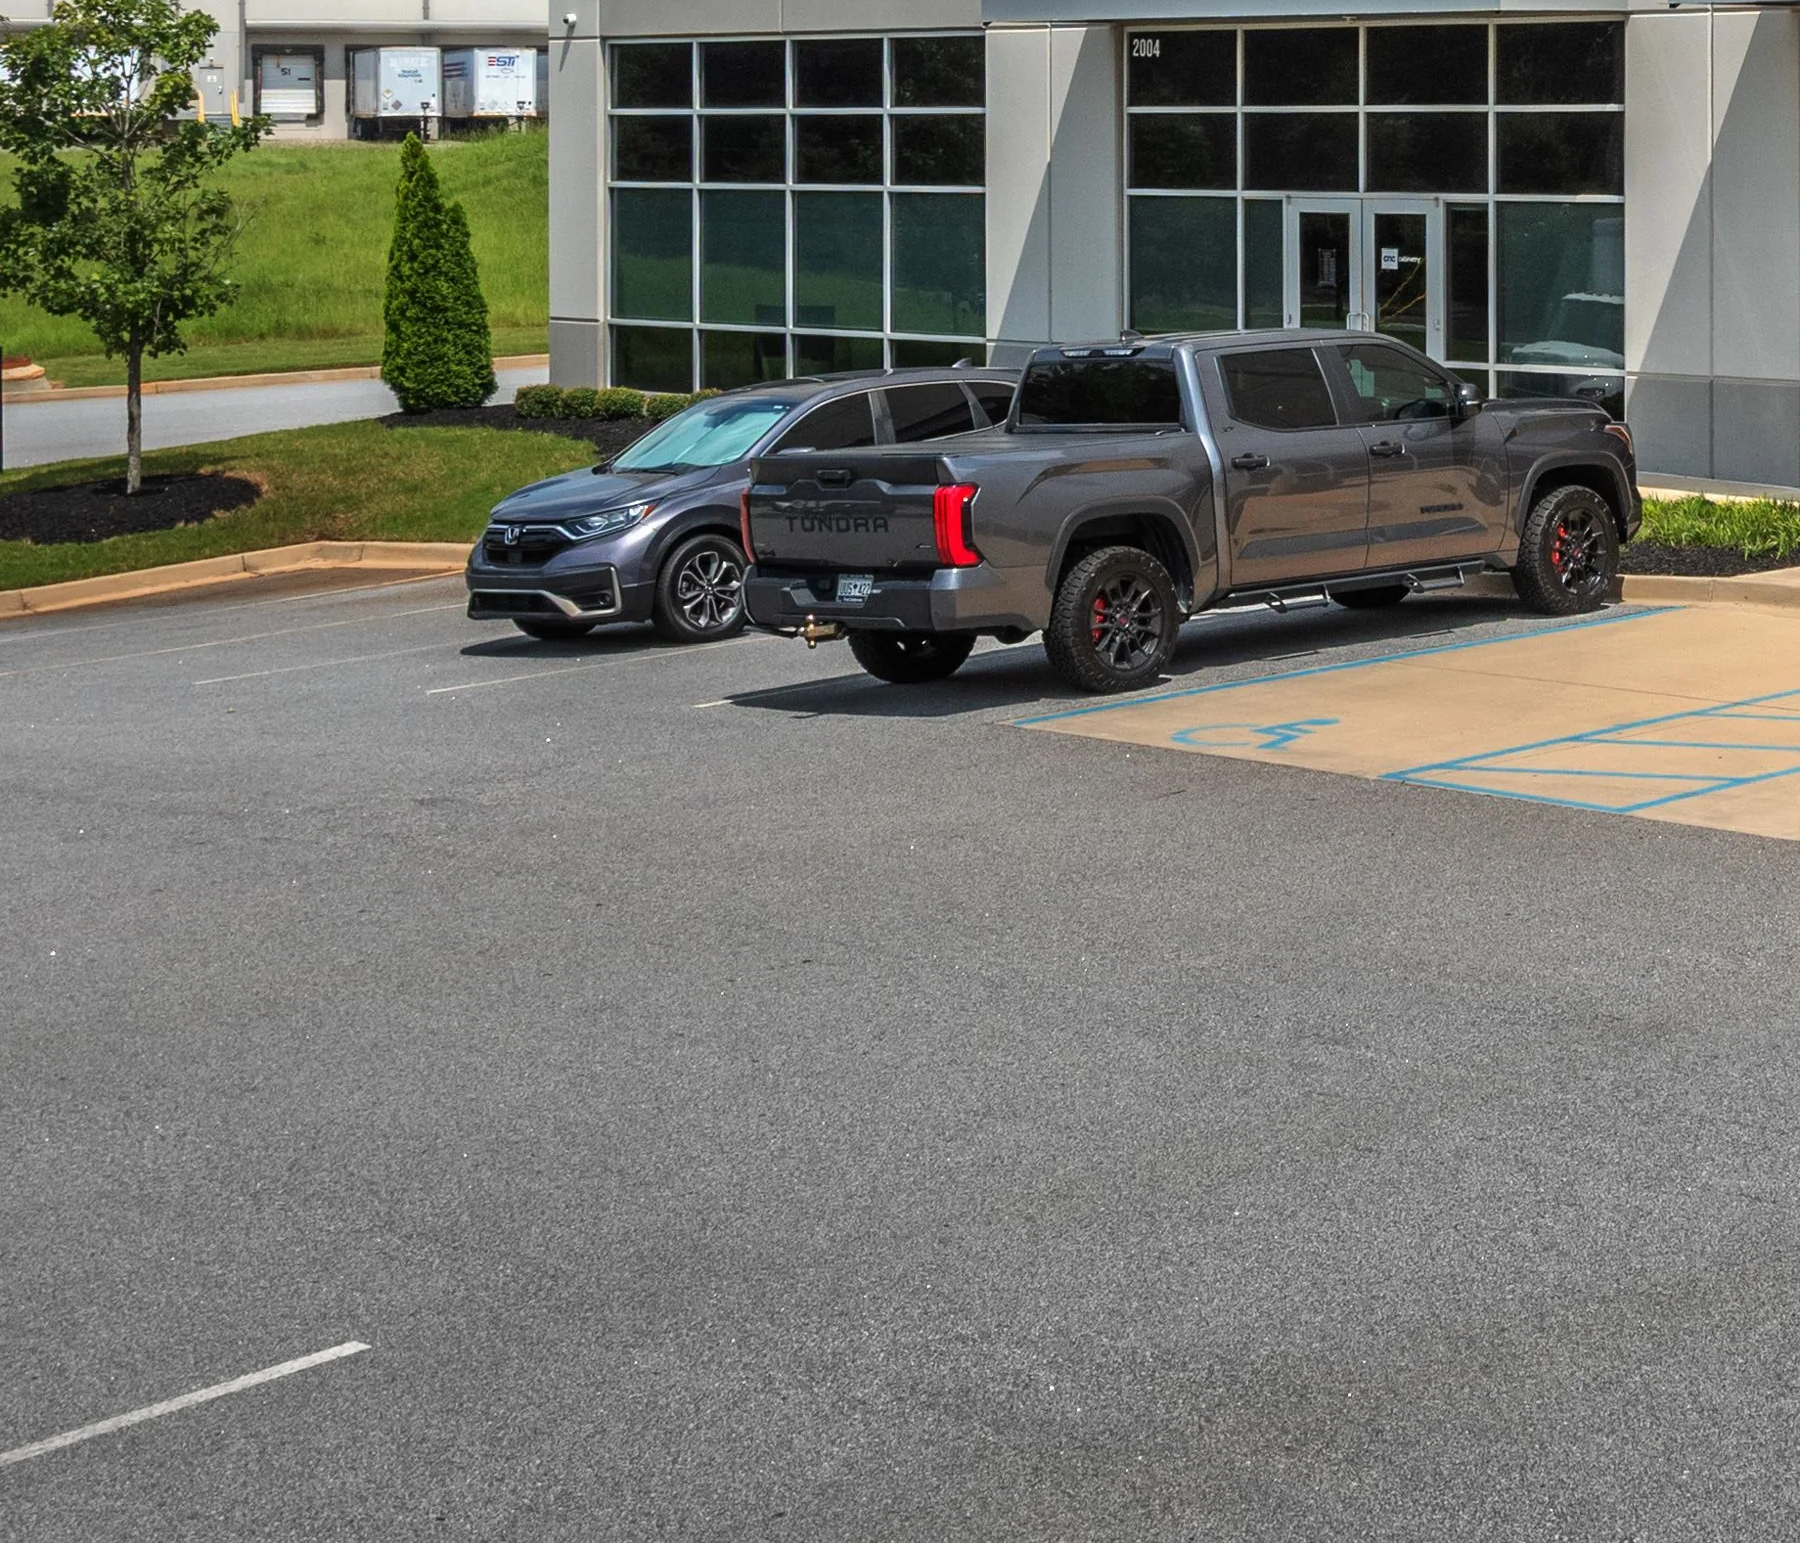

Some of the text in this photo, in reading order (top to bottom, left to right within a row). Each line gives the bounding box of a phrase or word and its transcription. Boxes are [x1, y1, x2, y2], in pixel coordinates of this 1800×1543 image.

[1133, 38, 1160, 57] 2004
[1383, 255, 1396, 263] cnc
[785, 515, 889, 534] TUNDRA
